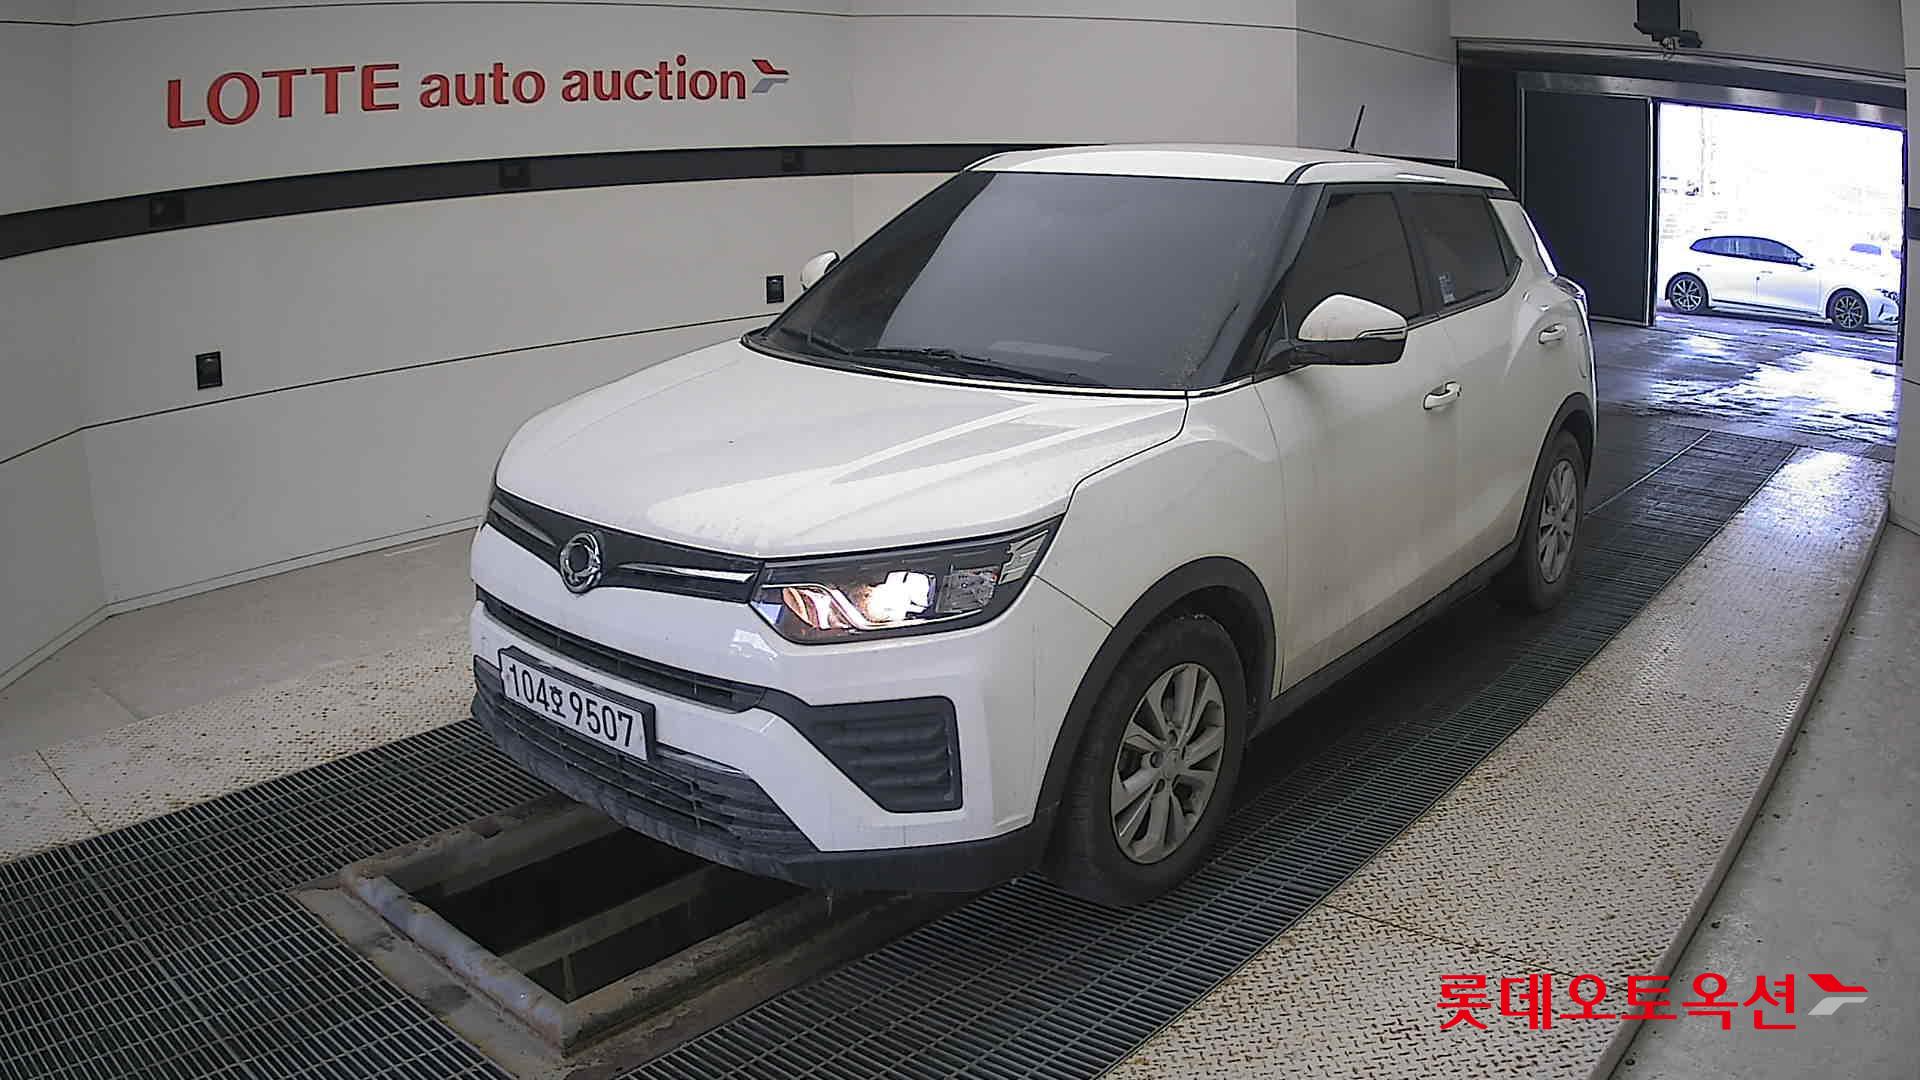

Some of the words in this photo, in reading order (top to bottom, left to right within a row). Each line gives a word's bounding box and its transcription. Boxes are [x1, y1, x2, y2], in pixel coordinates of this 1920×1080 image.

[166, 63, 401, 129] LOTTE
[418, 61, 547, 108] auto
[561, 55, 747, 103] auction
